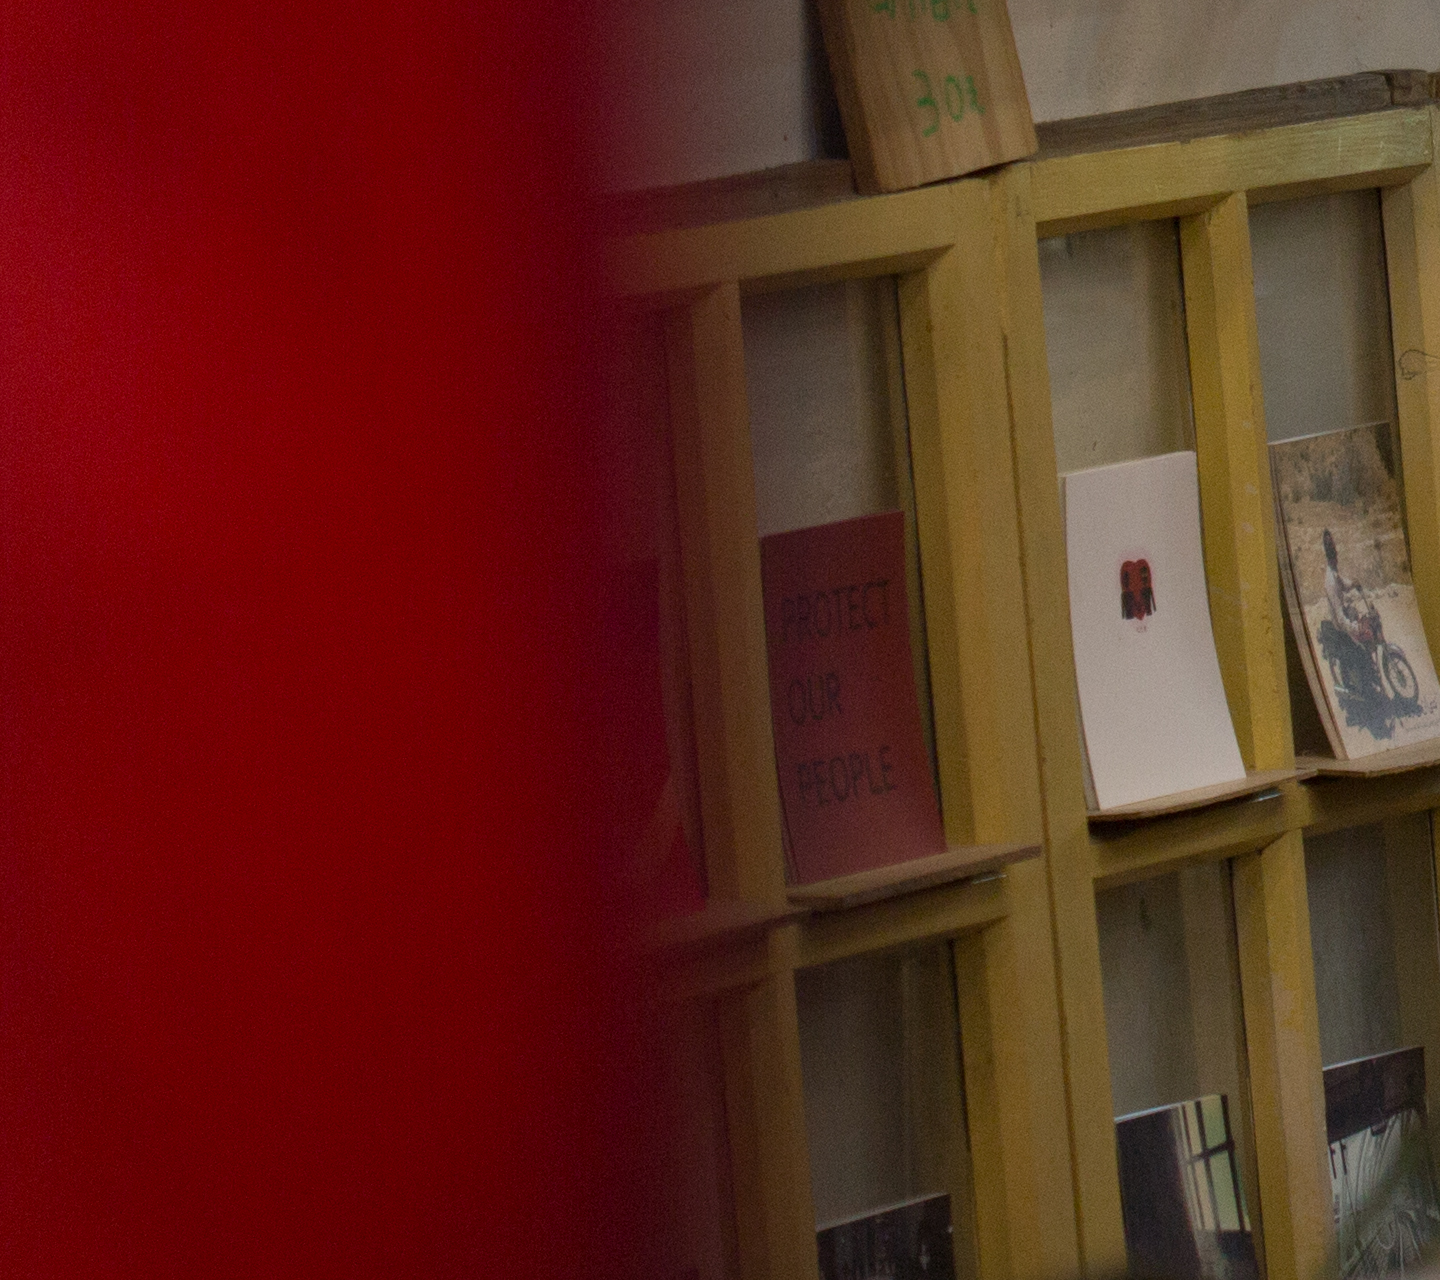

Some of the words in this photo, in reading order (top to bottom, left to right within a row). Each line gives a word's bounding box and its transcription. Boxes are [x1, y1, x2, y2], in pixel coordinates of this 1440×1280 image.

[781, 578, 890, 643] PROTECT
[788, 671, 843, 726] OUR
[797, 744, 895, 808] PEOPLE
